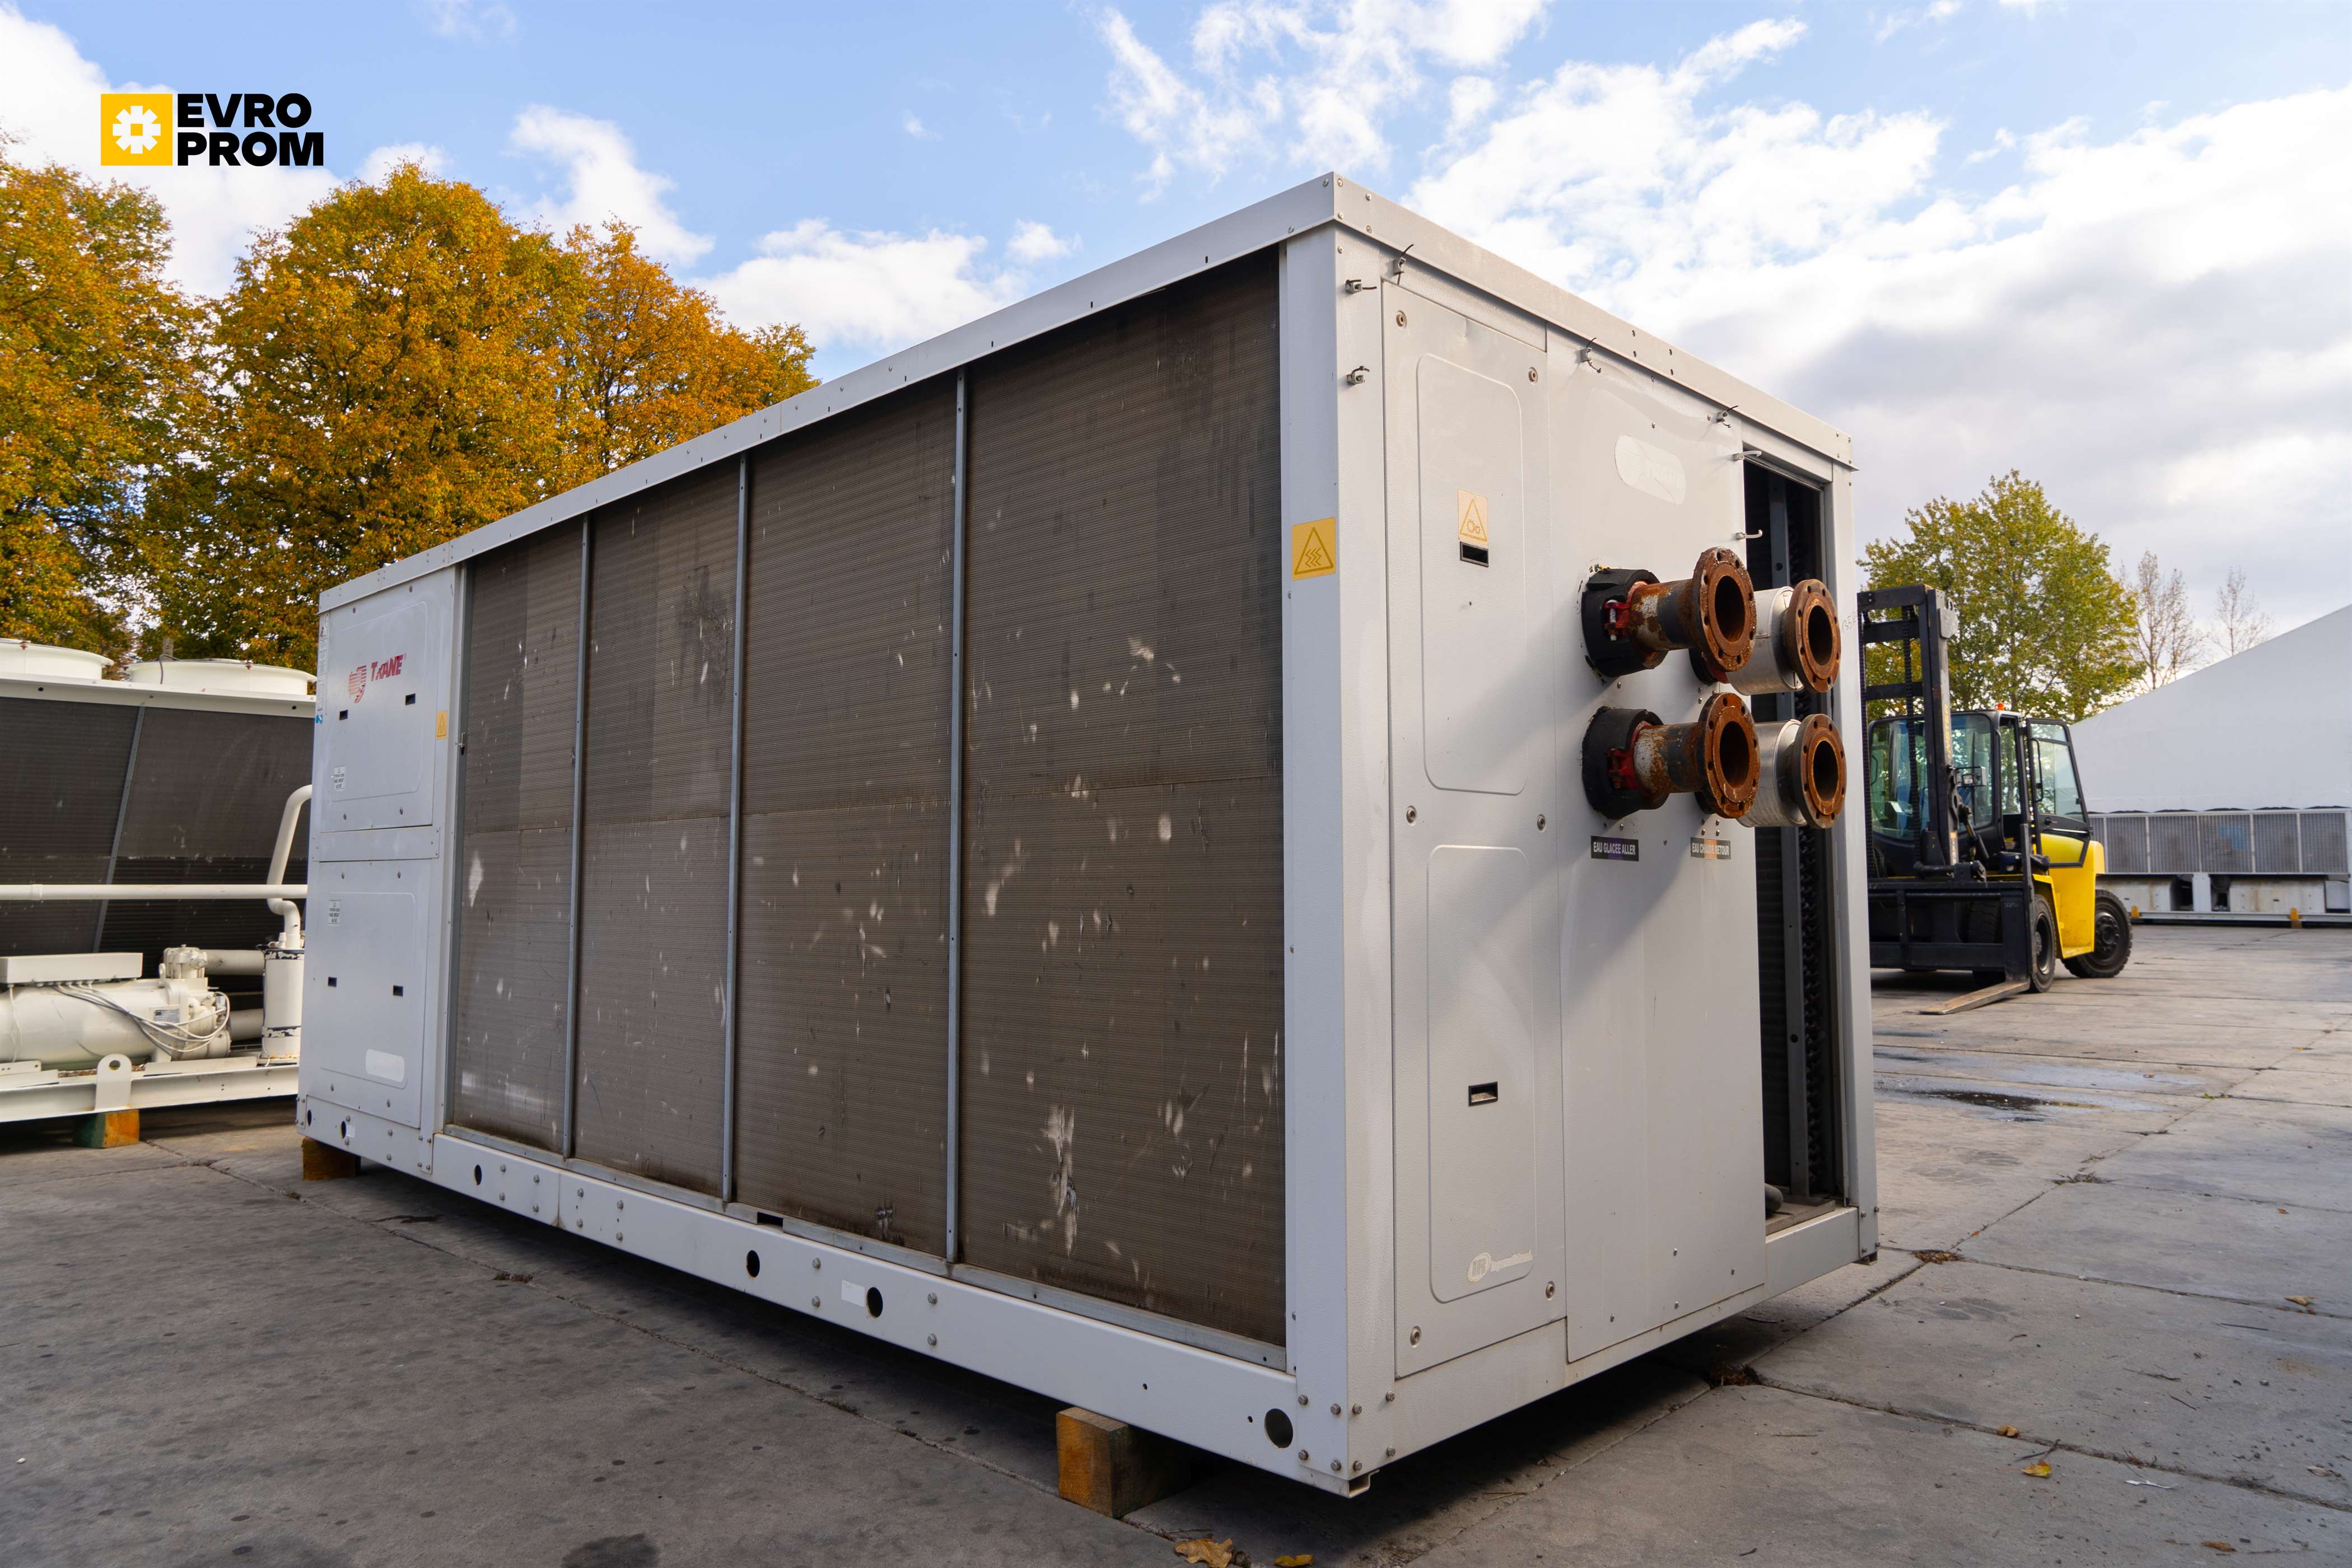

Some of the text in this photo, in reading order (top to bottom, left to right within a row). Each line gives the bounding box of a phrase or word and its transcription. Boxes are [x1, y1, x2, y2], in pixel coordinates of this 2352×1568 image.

[371, 654, 403, 682] TRANE
[1593, 842, 1603, 852] EAU
[1622, 844, 1636, 855] ALLER
[1715, 844, 1730, 856] RETOUR
